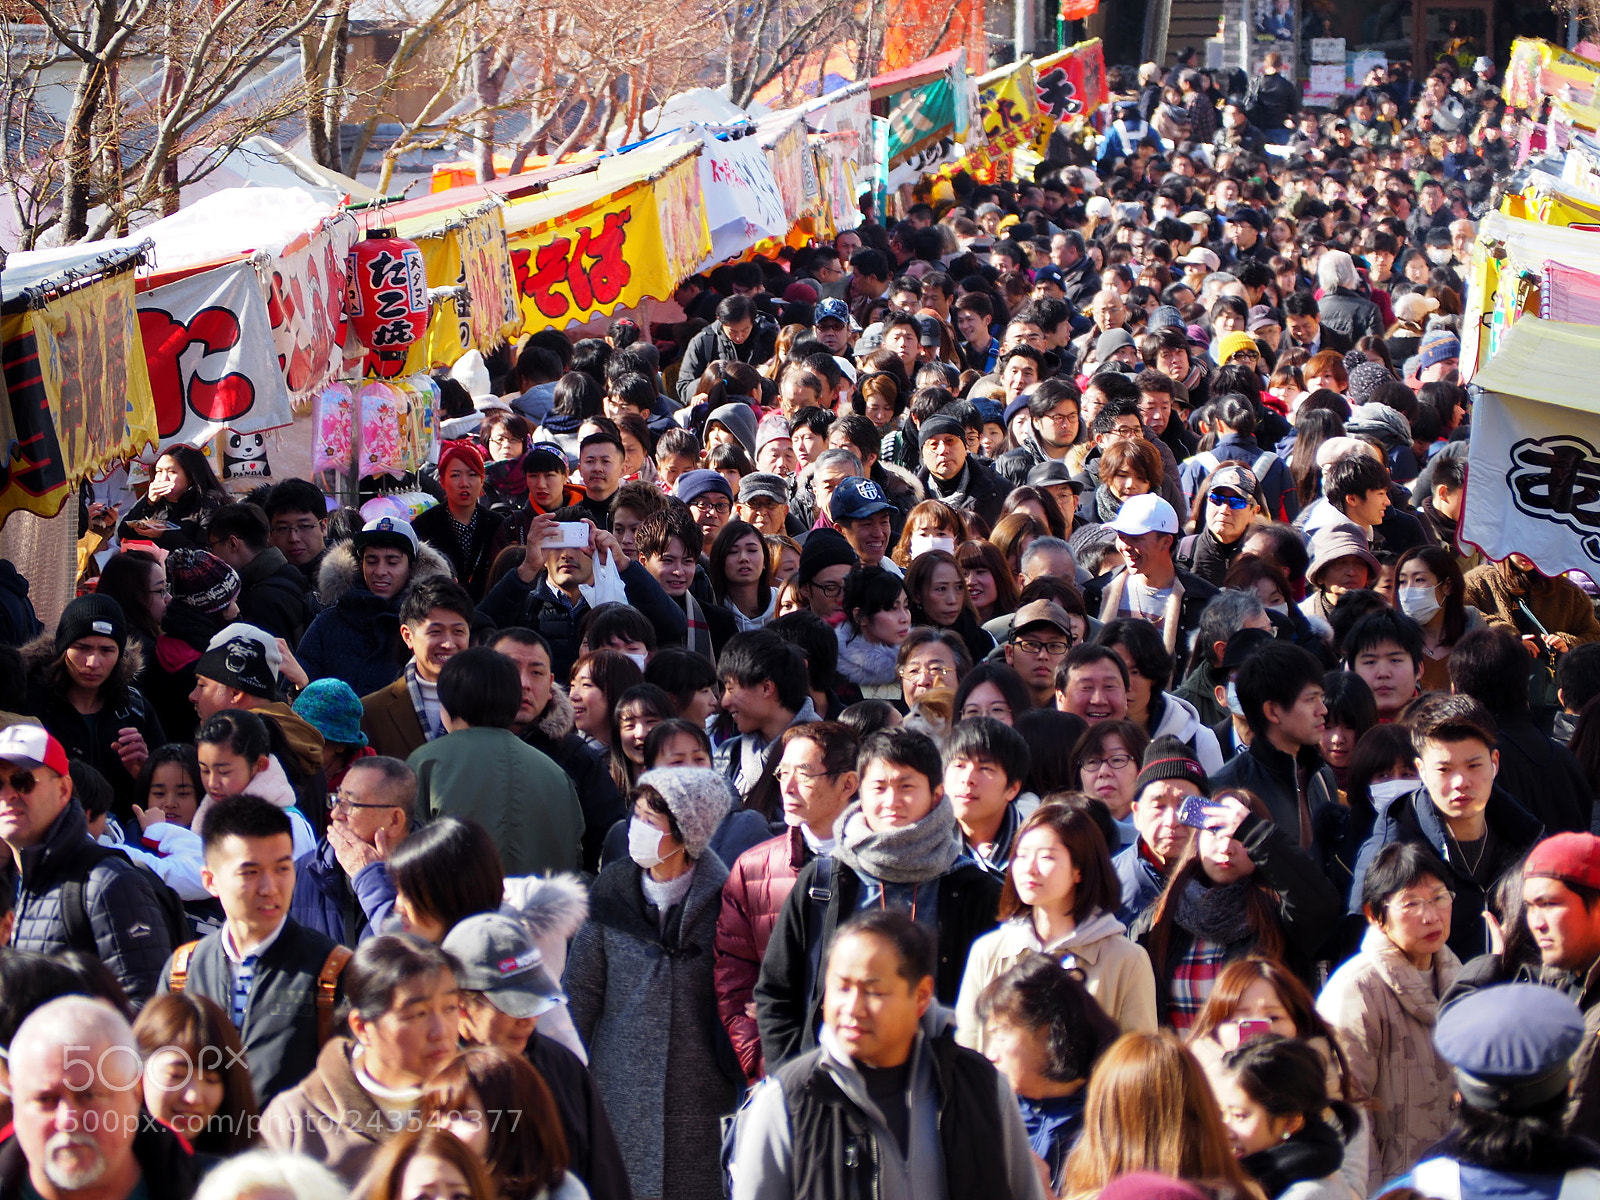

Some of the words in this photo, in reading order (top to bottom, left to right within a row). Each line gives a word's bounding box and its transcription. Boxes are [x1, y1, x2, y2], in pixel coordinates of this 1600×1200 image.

[366, 251, 416, 346] たこ焼
[232, 470, 263, 478] PANDA
